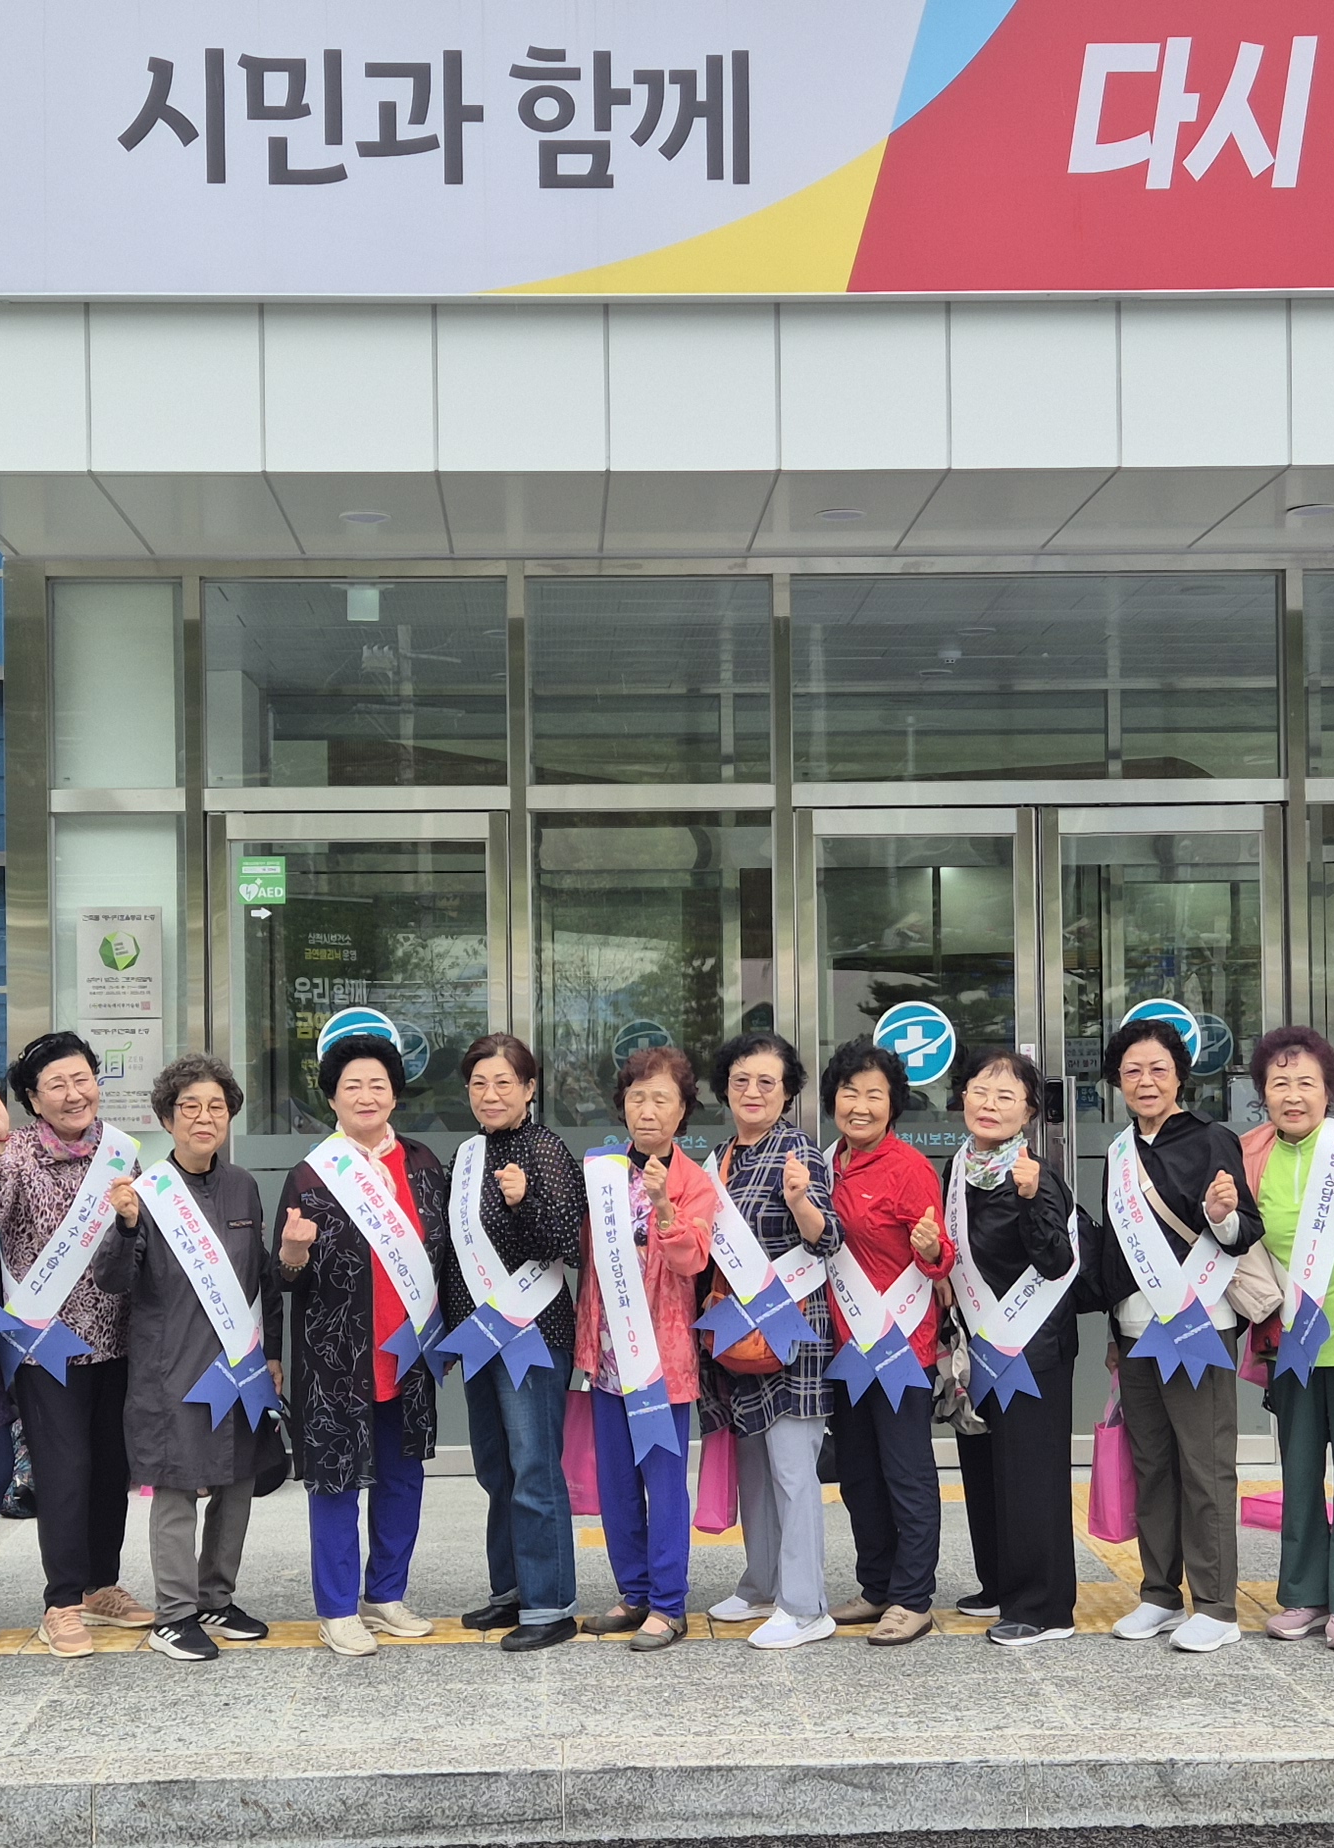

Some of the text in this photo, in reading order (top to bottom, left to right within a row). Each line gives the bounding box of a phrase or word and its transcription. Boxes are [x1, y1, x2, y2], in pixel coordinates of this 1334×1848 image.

[118, 45, 750, 189] 시민과 함께
[1067, 35, 1319, 190] 다시
[257, 887, 283, 898] AED
[294, 977, 368, 1005] 우리 함께
[896, 1132, 969, 1146] 척시보건소
[80, 1177, 116, 1248] 중한 생명
[353, 1170, 406, 1239] 소중한 생명
[1127, 1194, 1144, 1224] 생명
[30, 1193, 97, 1296] 지킬 수 있습니다
[172, 1192, 220, 1266] 소중한 생명
[356, 1202, 422, 1302] 지킬 수 있습니다
[1113, 1187, 1162, 1290] 지킬 수 있습니다
[172, 1225, 236, 1331] 지킬 수 있습니다
[472, 1252, 493, 1290] 109
[518, 1259, 551, 1293] 습니다
[600, 1183, 640, 1358] 자살예방 상담전화 109
[784, 1262, 814, 1284] 109
[1197, 1249, 1221, 1286] 109
[1303, 1239, 1318, 1281] 109
[828, 1262, 862, 1317] 있습니다
[896, 1284, 923, 1315] 109
[961, 1272, 982, 1313] 109
